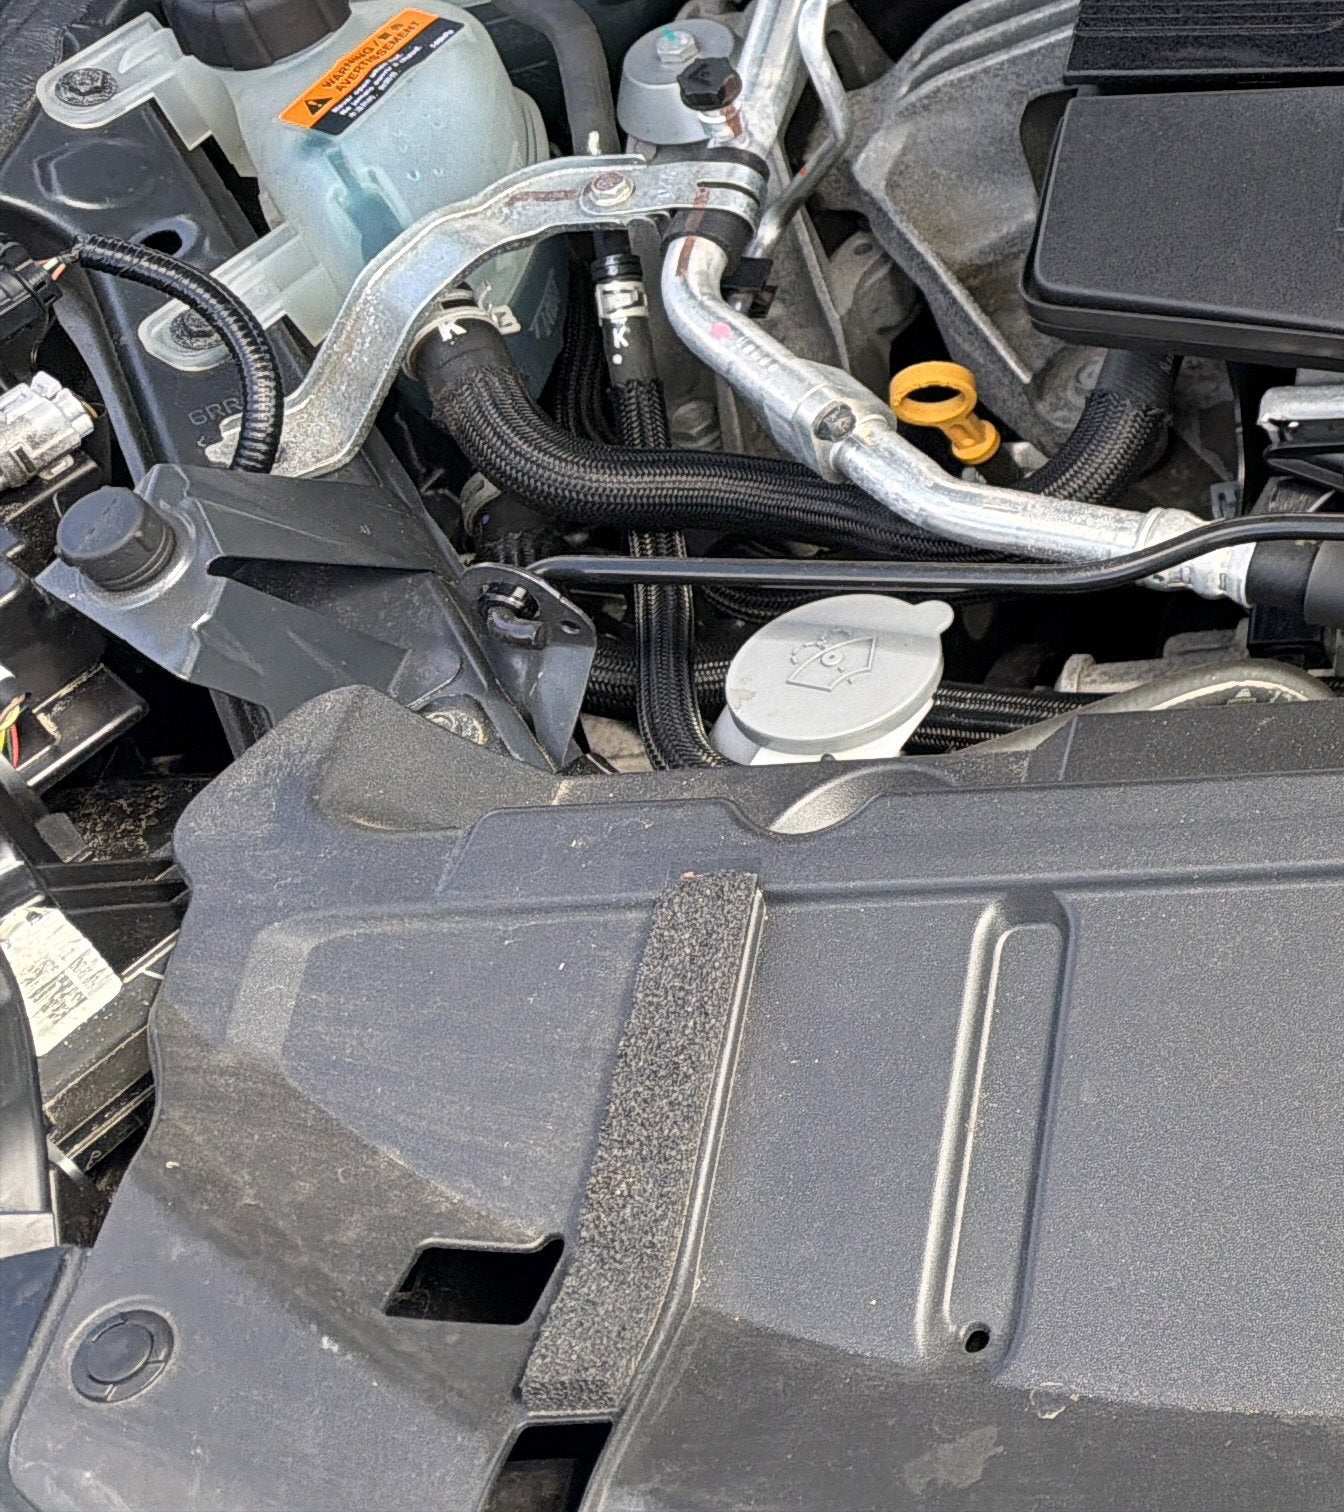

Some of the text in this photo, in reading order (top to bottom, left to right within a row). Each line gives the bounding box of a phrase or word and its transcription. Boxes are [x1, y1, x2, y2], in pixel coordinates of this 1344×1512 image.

[321, 46, 376, 89] WARNING
[335, 20, 420, 92] AVERTISSEMENT
[612, 326, 629, 349] K
